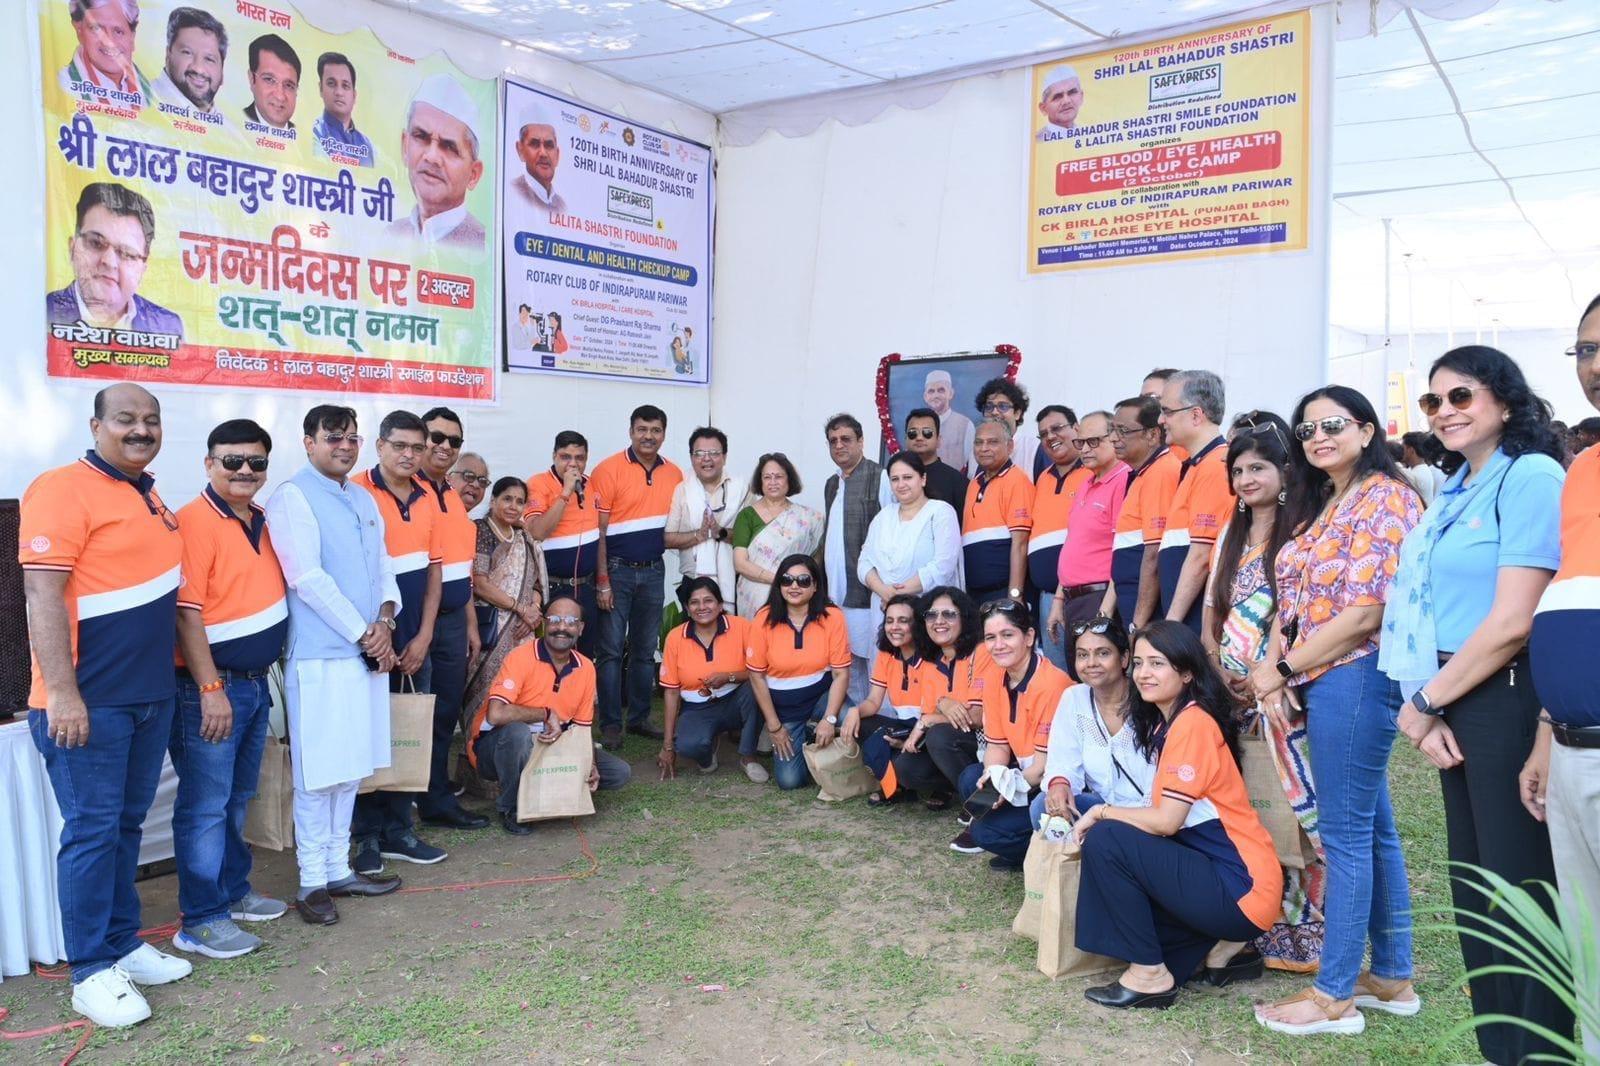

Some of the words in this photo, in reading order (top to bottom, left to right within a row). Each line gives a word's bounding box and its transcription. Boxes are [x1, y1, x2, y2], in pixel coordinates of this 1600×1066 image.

[236, 0, 267, 24] भारत
[270, 9, 292, 30] रत्न
[1094, 64, 1125, 80] SHRI
[1129, 58, 1154, 74] LAL
[1158, 45, 1226, 68] BAHADUR
[1230, 32, 1294, 54] SHASTRI
[1113, 50, 1140, 63] 120th
[1143, 44, 1174, 57] BIRTH
[1177, 27, 1253, 50] ANNIVERSARY
[1257, 24, 1272, 35] OF
[70, 80, 108, 97] अनिल
[110, 88, 142, 106] शास्त्री
[1153, 67, 1217, 89] SAFEXPRESS
[158, 102, 190, 119] आदर्श
[193, 108, 224, 126] शास्त्री
[1043, 129, 1064, 142] LAL
[1067, 121, 1120, 139] BAHADUR
[1122, 113, 1172, 129] SHASTRI
[1175, 106, 1212, 121] SMILE
[1215, 92, 1297, 115] FOUNDATION
[271, 125, 297, 141] शास्त्री
[1074, 138, 1083, 149] &
[1085, 133, 1124, 149] LALITA
[1127, 124, 1177, 141] SHASTRI
[1180, 111, 1259, 133] FOUNDATION
[1140, 136, 1182, 149] organizes
[344, 141, 368, 158] शास्त्री
[570, 136, 599, 155] 120TH
[601, 146, 628, 163] BIRTH
[630, 154, 685, 181] ANNIVERSARY
[686, 172, 698, 184] OF
[1060, 161, 1097, 174] FREE
[1101, 152, 1153, 169] BLOOD
[1165, 145, 1197, 159] EYE
[1210, 133, 1276, 153] HEALTH
[58, 113, 97, 169] श्री
[105, 135, 181, 185] लाल
[186, 151, 277, 215] बहादुर
[282, 168, 355, 215] शास्त्री
[361, 177, 396, 222] जी
[573, 156, 597, 172] SHRI
[599, 163, 616, 179] LAL
[618, 169, 658, 191] BAHADUR
[659, 181, 695, 199] SHASTRI
[1090, 160, 1182, 184] CHECK-UP
[1187, 151, 1242, 169] CAMP
[1123, 178, 1136, 188] (2
[1140, 169, 1204, 185] October)
[1038, 202, 1083, 217] ROTARY
[1086, 198, 1118, 211] CLUB
[1120, 196, 1137, 206] OF
[1140, 185, 1229, 204] INDIRAPURAM
[1232, 177, 1293, 193] PARIWAR
[1130, 183, 1180, 196] collaboration
[1181, 179, 1200, 189] with
[308, 221, 332, 239] के
[1041, 222, 1061, 233] CK
[1065, 216, 1109, 230] BIRLA
[1113, 208, 1189, 225] HOSPITAL
[1194, 203, 1249, 217] (PUNJABI
[1251, 198, 1290, 211] BAGH)
[1065, 231, 1076, 241] &
[1093, 225, 1139, 238] ICARE
[1143, 221, 1175, 233] EYE
[1179, 211, 1260, 229] HOSPITAL
[549, 212, 582, 231] LALITA
[584, 219, 623, 240] SHASTRI
[624, 229, 678, 251] FOUNDATION
[1073, 243, 1097, 252] Bahadur
[1098, 241, 1120, 249] Shastri
[1224, 228, 1239, 236] New
[526, 237, 544, 254] EYE
[552, 243, 585, 262] DENTAL
[587, 252, 605, 265] AND
[606, 254, 637, 270] HEALTH
[638, 260, 671, 277] CHECKUP
[672, 268, 690, 282] CAMP
[1078, 251, 1094, 259] Time
[1115, 248, 1125, 256] AM
[1188, 239, 1213, 249] October
[1222, 237, 1239, 245] 2024
[179, 224, 361, 301] जन्मदिवस
[367, 258, 411, 307] पर
[420, 274, 429, 296] 2
[431, 278, 471, 305] अक्टूबर
[526, 269, 563, 287] ROTARY
[565, 276, 587, 290] CLUB
[589, 279, 600, 292] OF
[602, 281, 656, 302] INDIRAPURAM
[657, 291, 688, 307] PARIWAR
[52, 320, 111, 344] नरेश
[114, 328, 180, 350] वाधवा
[365, 310, 440, 346] नमन
[73, 350, 113, 367] मुख्य
[215, 349, 269, 371] निवेदक
[283, 358, 313, 376] लाल
[358, 362, 394, 382] शास्त्री
[391, 739, 421, 747] EXPRESS
[532, 764, 578, 776] SAFEXPRESS
